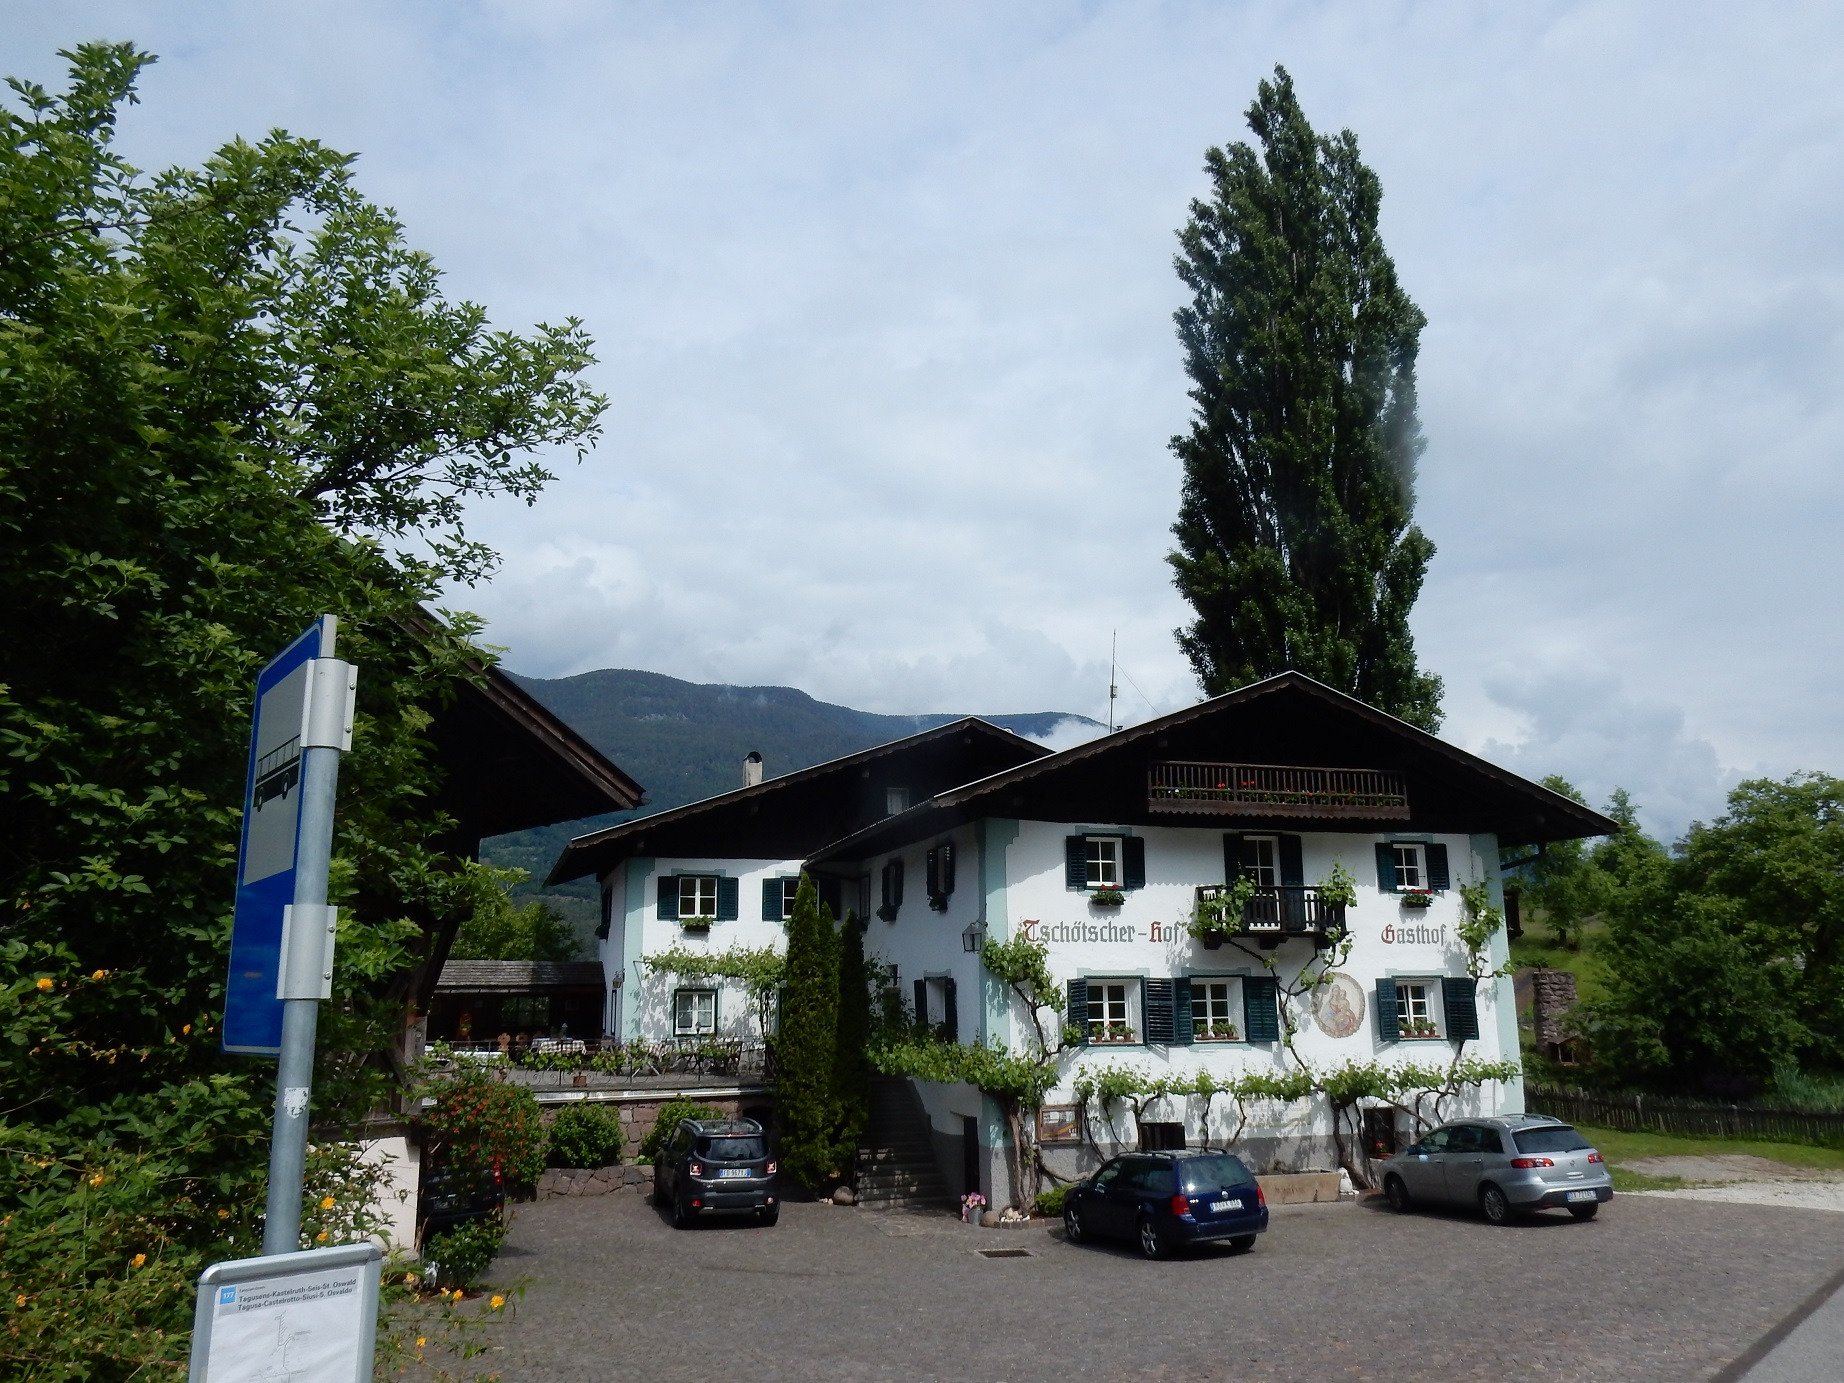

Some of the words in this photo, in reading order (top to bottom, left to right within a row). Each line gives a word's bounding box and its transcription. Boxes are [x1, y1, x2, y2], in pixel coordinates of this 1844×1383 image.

[1381, 923, 1447, 946] Gasthof
[332, 1278, 357, 1289] Oswald
[327, 1287, 353, 1298] Osvaldo
